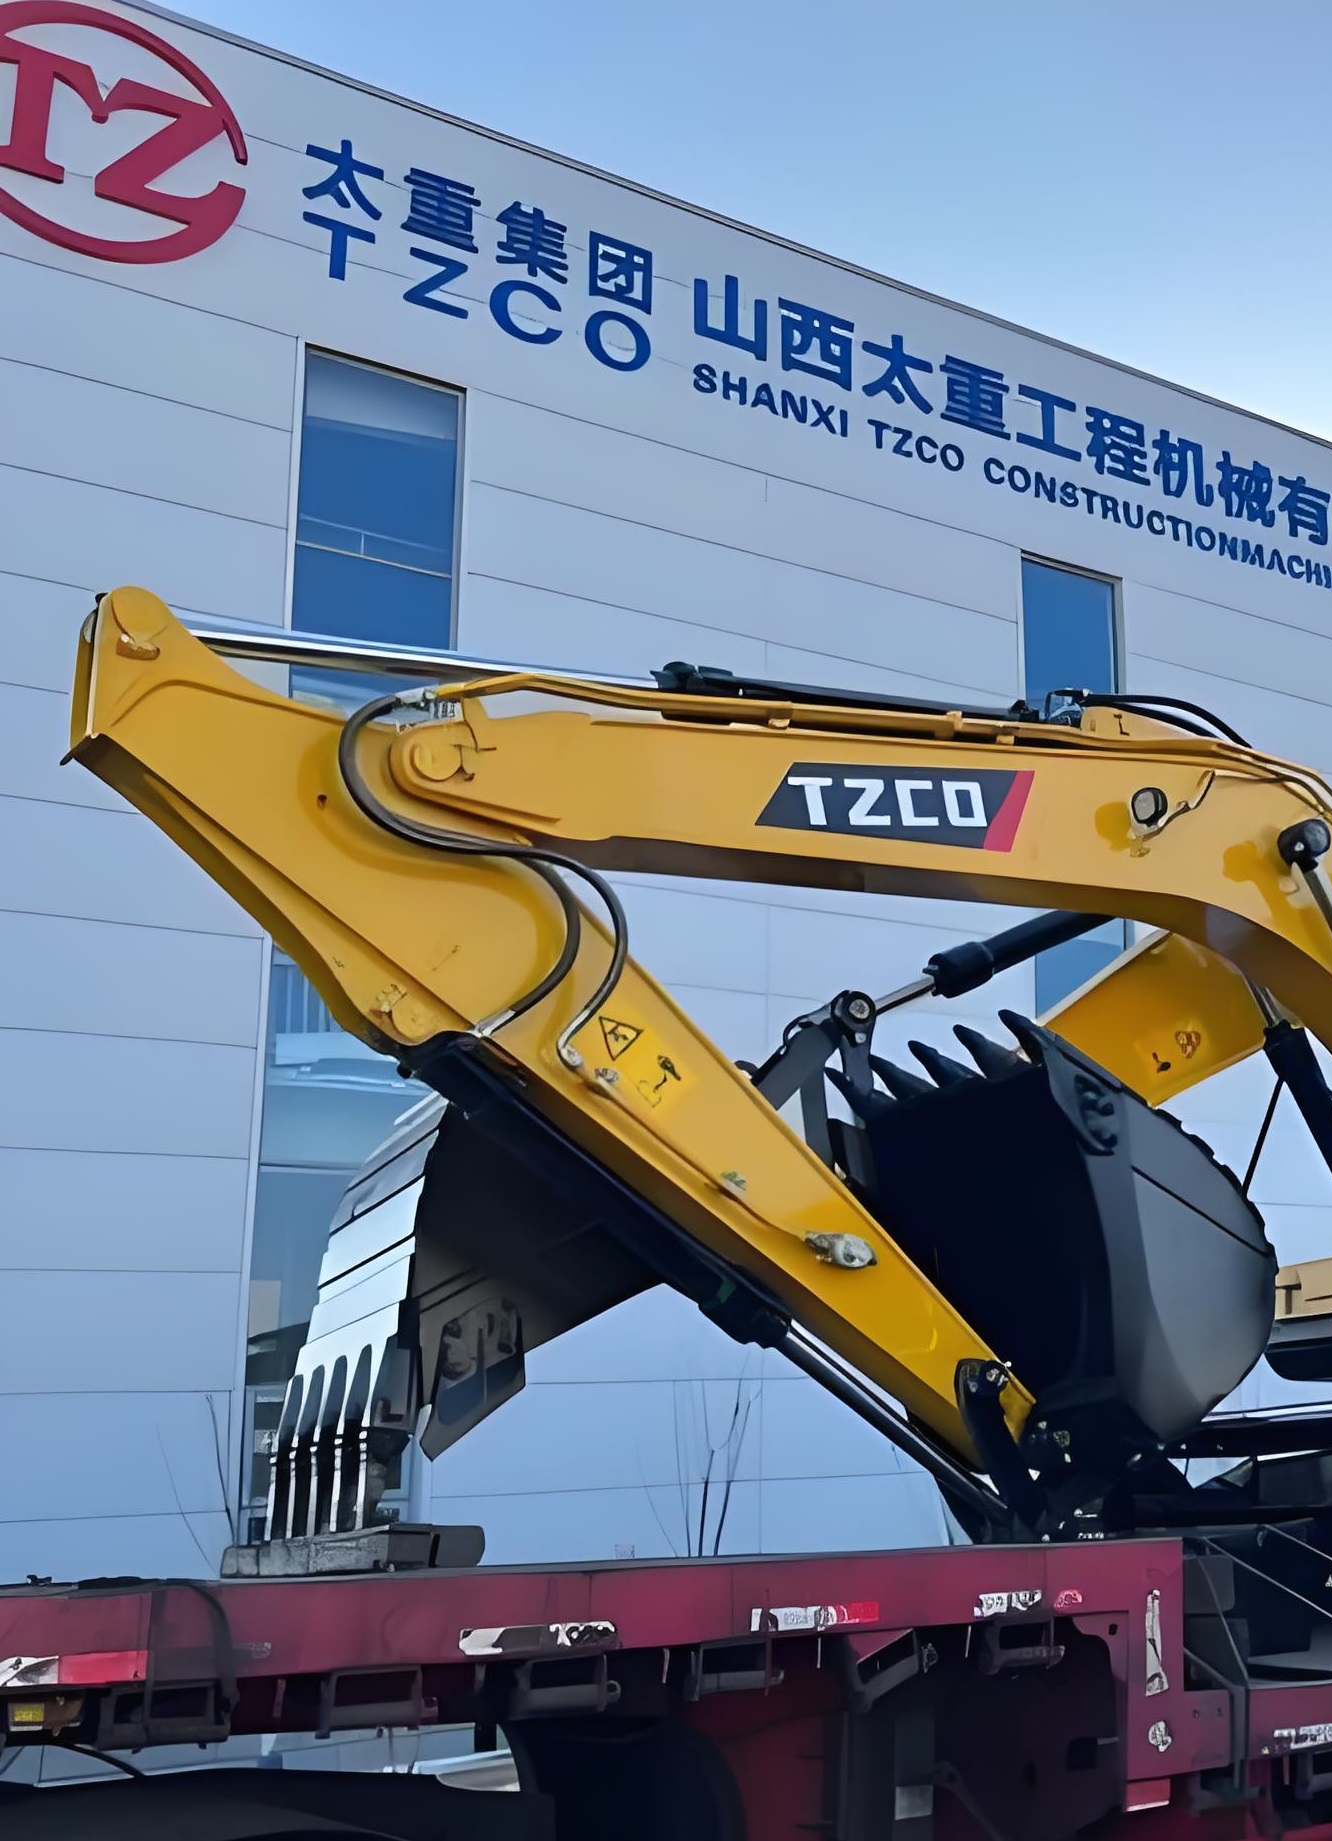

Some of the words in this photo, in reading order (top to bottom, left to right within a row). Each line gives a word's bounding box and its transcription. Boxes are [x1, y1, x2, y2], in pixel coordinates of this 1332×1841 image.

[302, 139, 653, 315] 太重集团
[303, 211, 652, 372] TZCO
[692, 363, 849, 438] SHANXI
[866, 418, 965, 472] TZCO
[787, 776, 988, 828] TZCO
